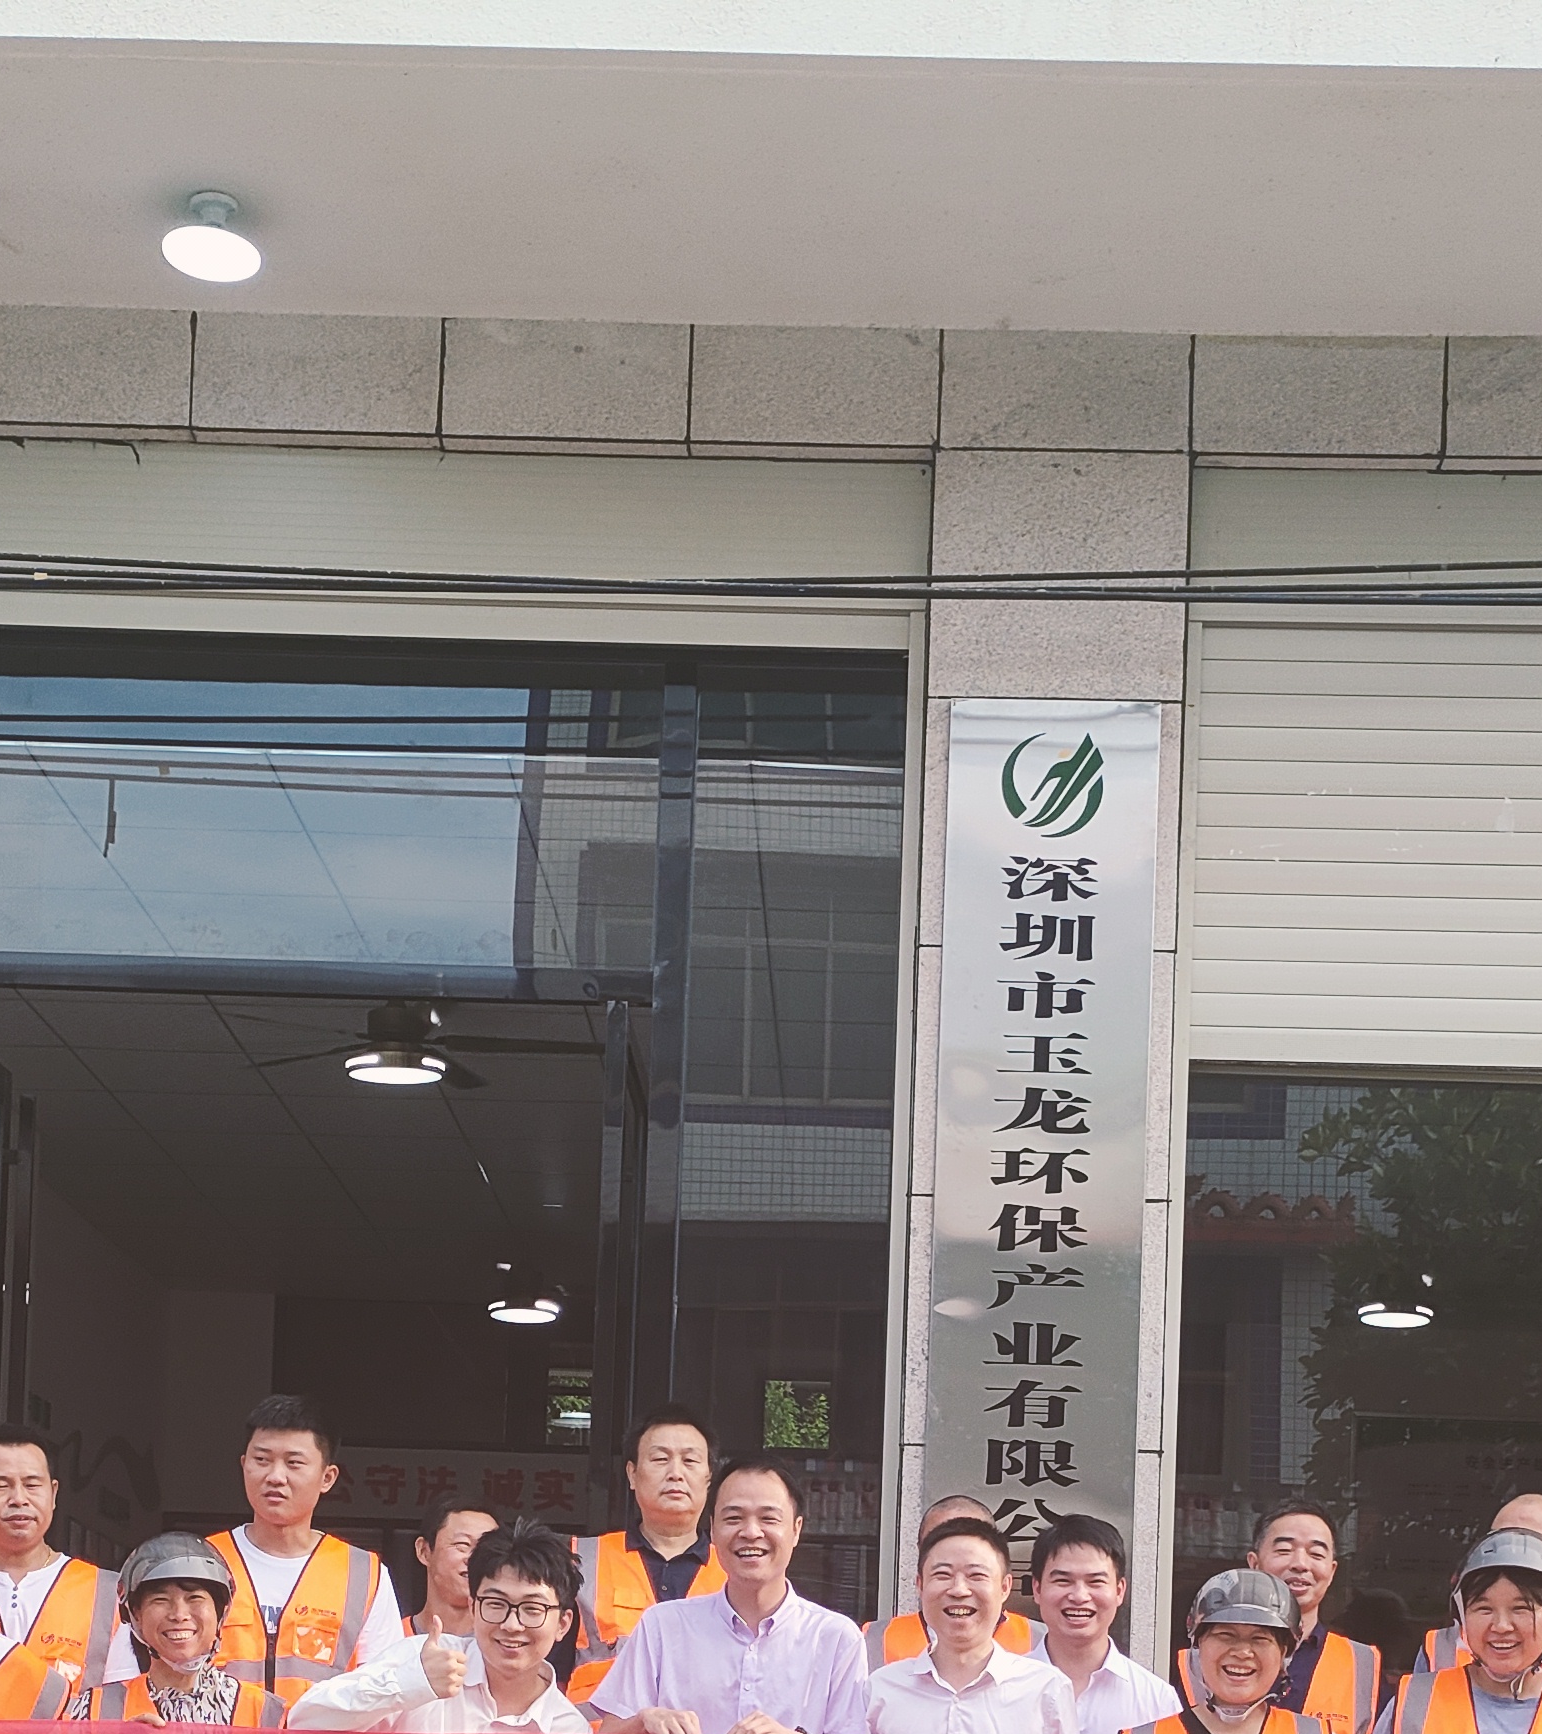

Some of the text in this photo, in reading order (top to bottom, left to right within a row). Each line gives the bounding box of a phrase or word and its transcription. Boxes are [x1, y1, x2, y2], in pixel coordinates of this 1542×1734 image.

[981, 855, 1100, 1597] 深圳市玉龙环保产业有限公
